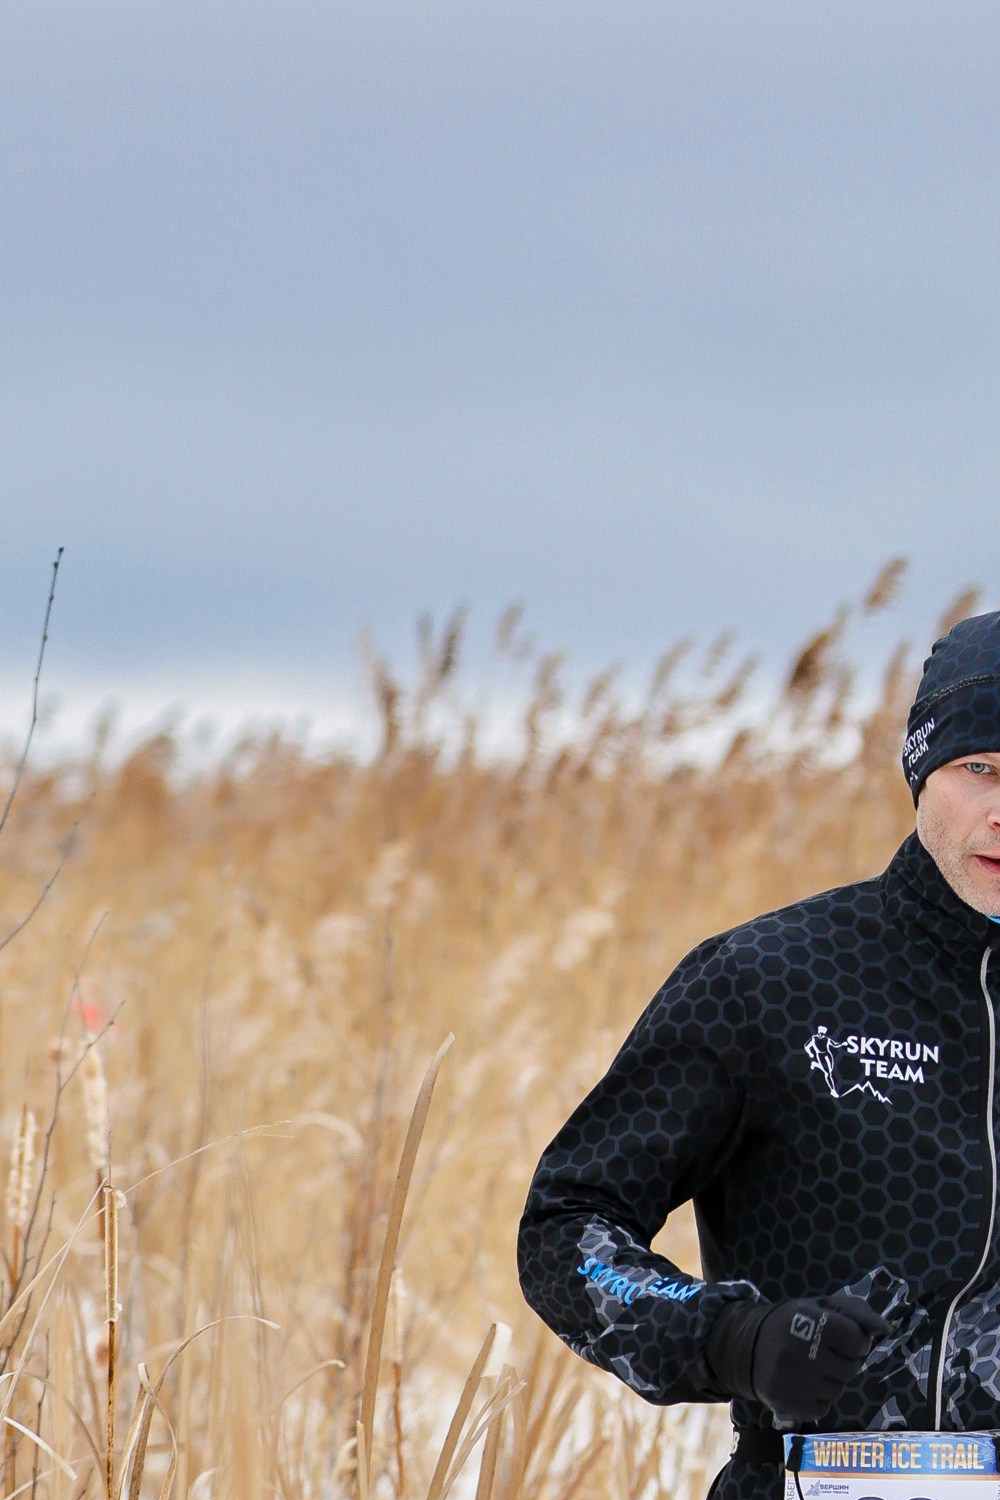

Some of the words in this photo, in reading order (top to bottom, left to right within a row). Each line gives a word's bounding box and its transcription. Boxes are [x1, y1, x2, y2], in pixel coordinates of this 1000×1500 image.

[846, 1035, 940, 1064] SKYRUN
[859, 1058, 925, 1084] TEAM
[577, 1257, 644, 1306] SKYRU
[649, 1277, 701, 1304] EAM
[813, 1441, 884, 1468] WINTER
[891, 1442, 922, 1469] ICE
[929, 1443, 985, 1470] TRAIL
